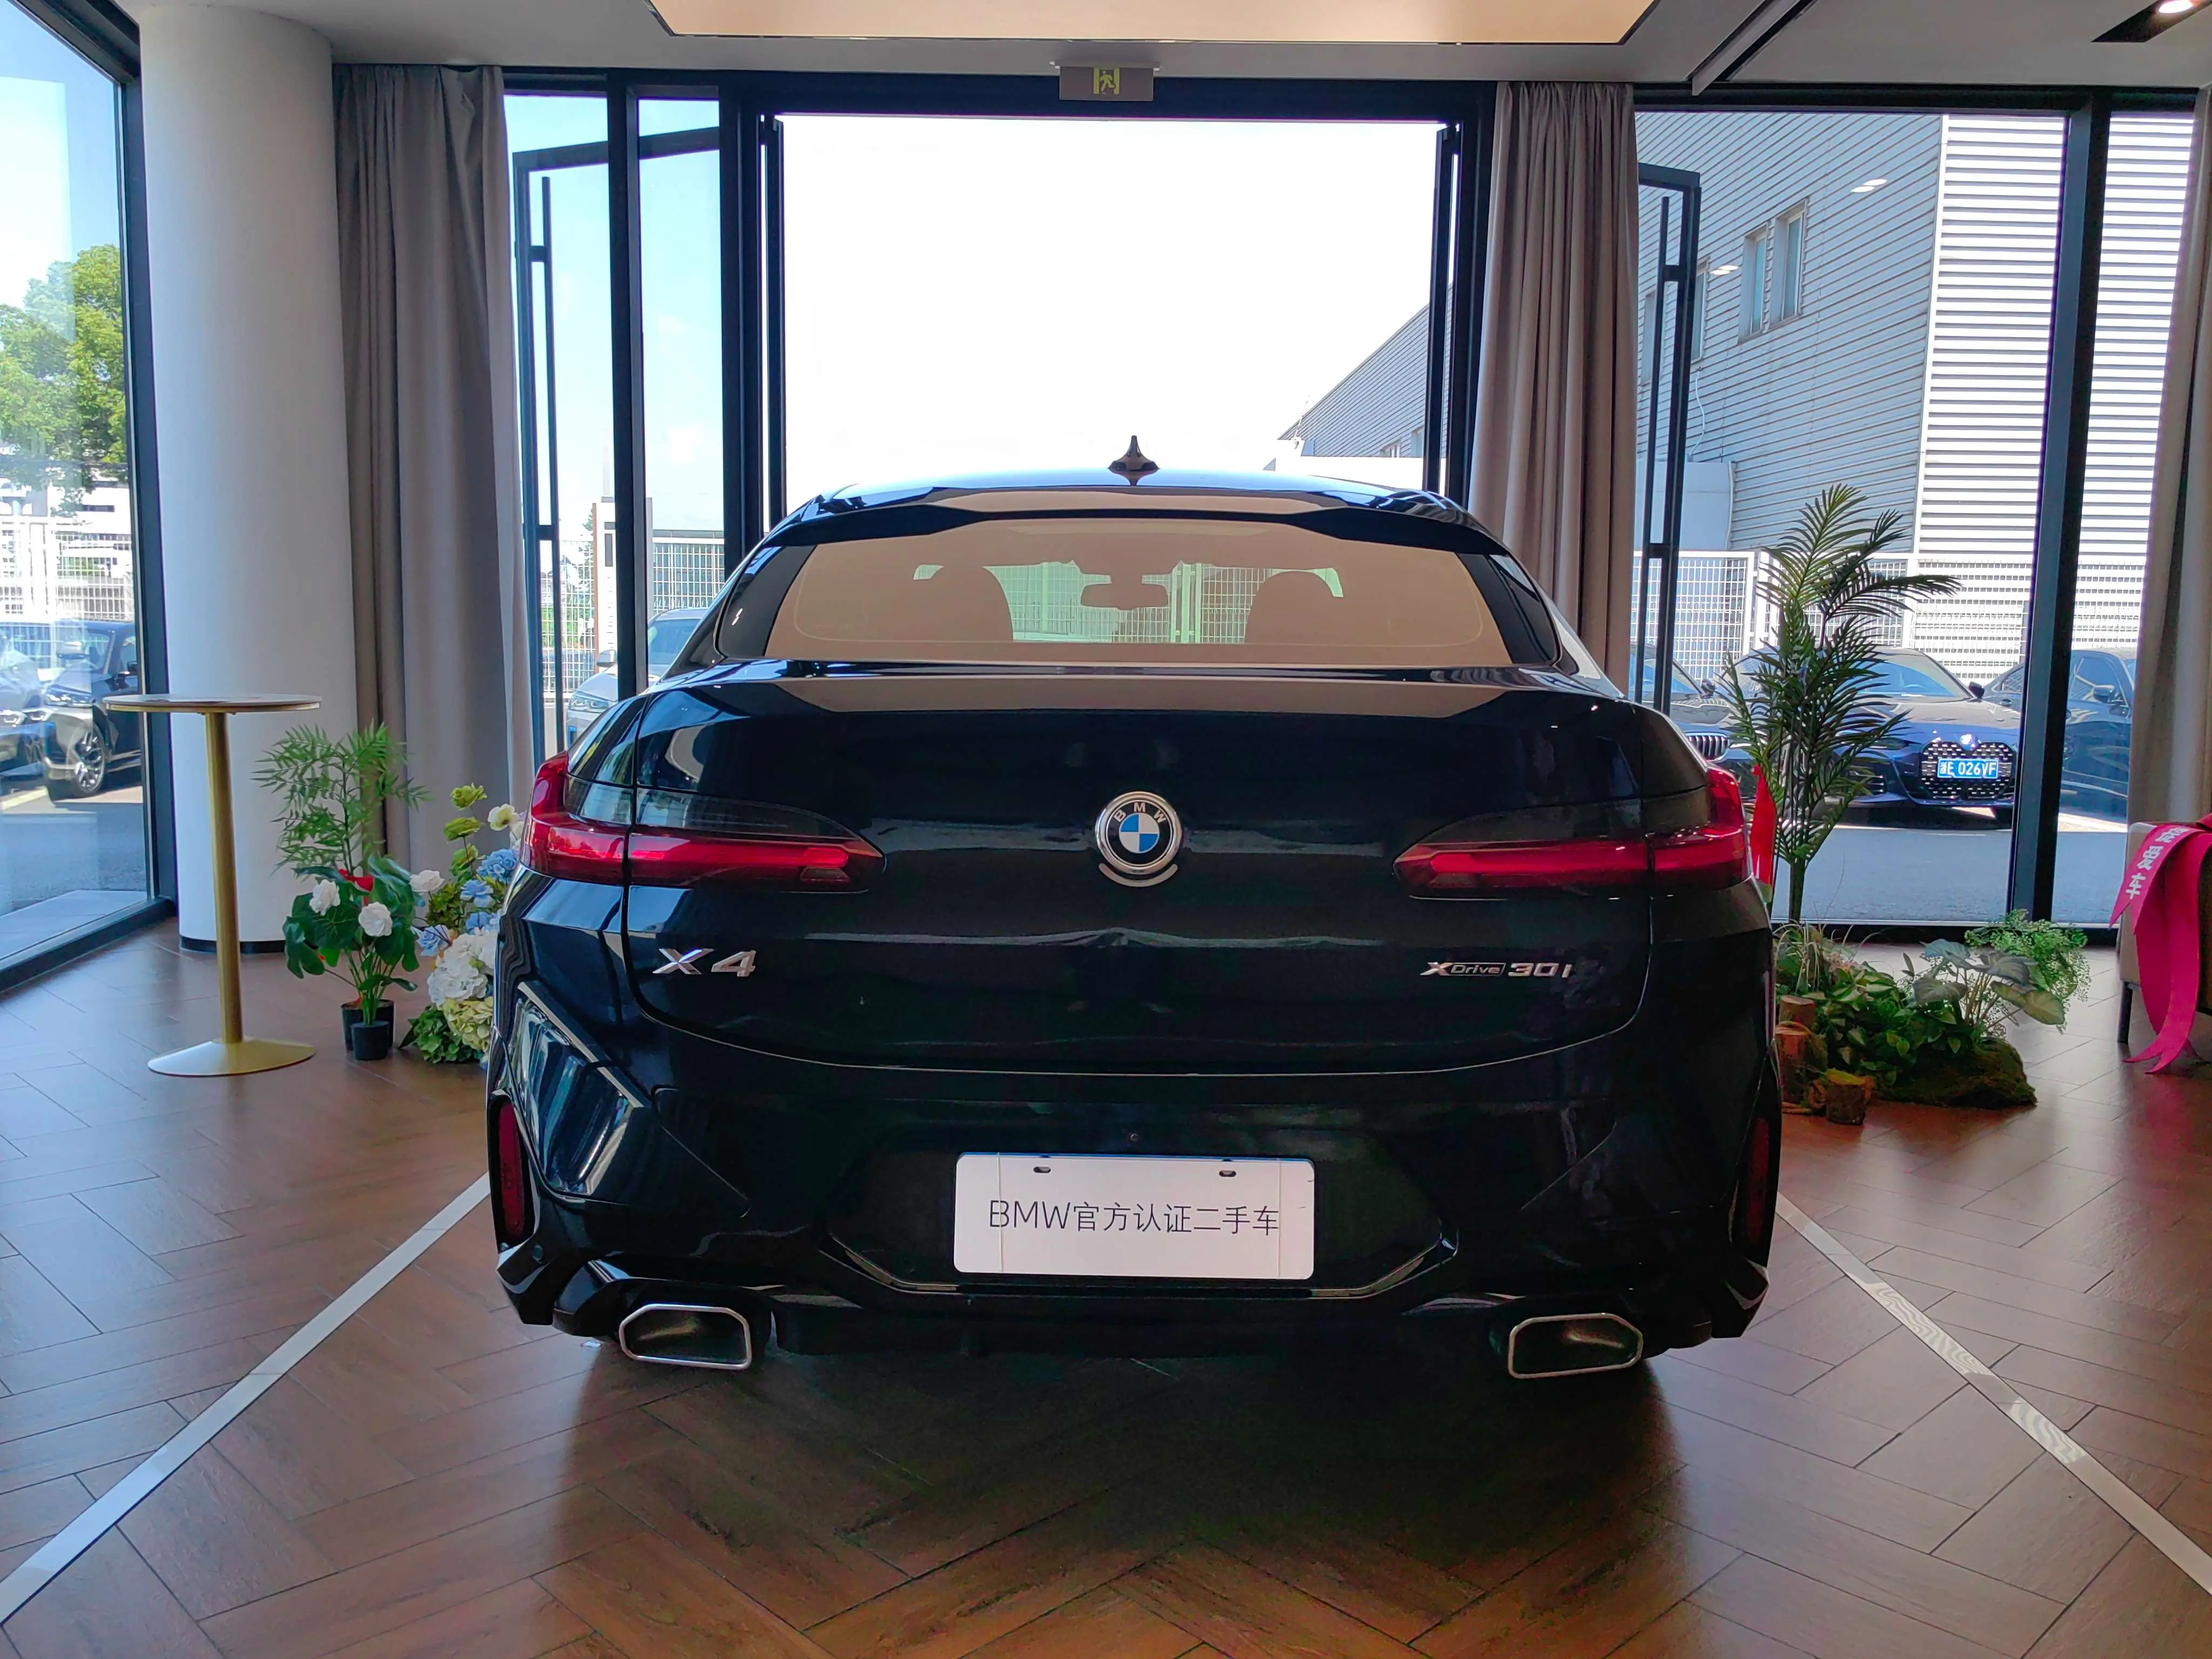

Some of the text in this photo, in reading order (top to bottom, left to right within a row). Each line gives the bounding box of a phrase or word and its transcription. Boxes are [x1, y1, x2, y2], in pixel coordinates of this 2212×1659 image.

[1114, 802, 1166, 823] BMW
[989, 1199, 1279, 1235] BMW官方认证二手车
